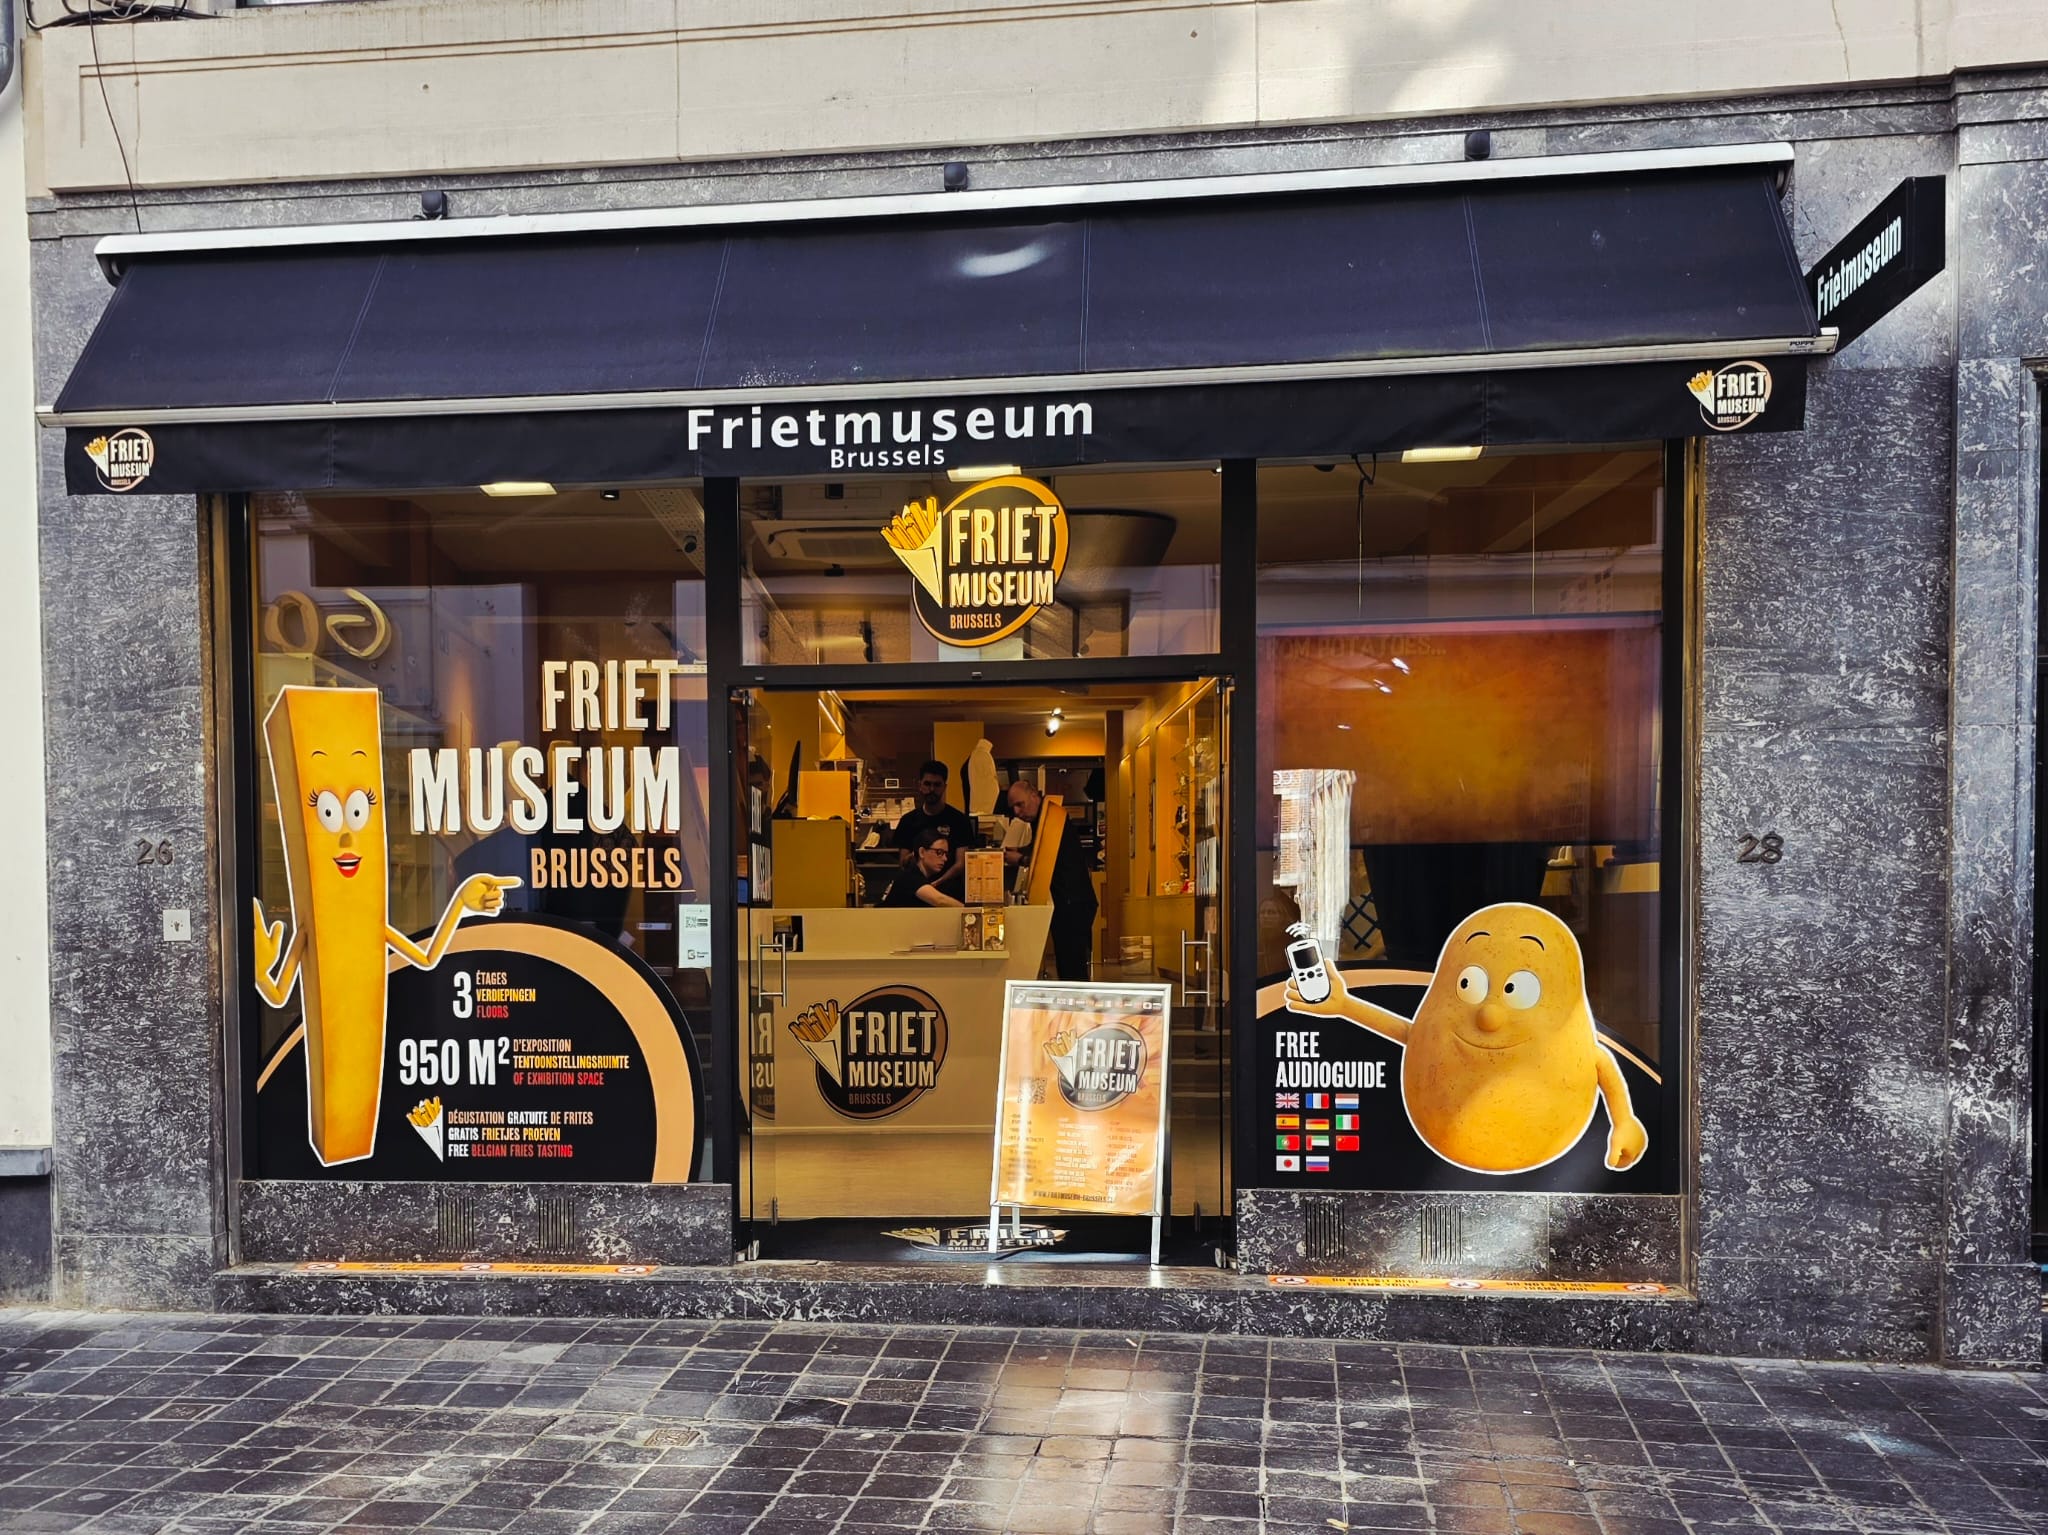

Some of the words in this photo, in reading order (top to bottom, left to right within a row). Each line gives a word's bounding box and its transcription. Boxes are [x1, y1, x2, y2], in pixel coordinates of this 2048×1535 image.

[1817, 215, 1902, 322] Frietmuseum
[1716, 371, 1768, 398] FRIET
[1716, 397, 1766, 415] MUSEUM
[687, 401, 1094, 451] Frietmuseum
[109, 438, 150, 462] FRIET
[830, 444, 945, 469] Brussels
[110, 461, 150, 478] MUSEUM
[949, 506, 1058, 567] FRIET
[949, 570, 1055, 608] MUSEUM
[949, 613, 1002, 630] BRUSSELS
[542, 659, 679, 732] FRIET
[408, 746, 681, 835] MUSEUM
[136, 838, 174, 866] 26
[1736, 831, 1784, 865] 28
[531, 847, 683, 889] BRUSSELS
[475, 970, 508, 985] ÉTAGES
[452, 970, 473, 1019] 3
[475, 988, 536, 1002] VERDIEPINGEN
[475, 1004, 509, 1019] FLOORS
[513, 1038, 572, 1052] D'EXPOSITION
[848, 1011, 937, 1056] FRIET
[1275, 1031, 1320, 1058] FREE
[399, 1038, 460, 1086] 950
[513, 1055, 630, 1070] TENTOONSTELLINGSRUIMTE
[1080, 1038, 1141, 1071] FRIET
[513, 1071, 524, 1086] OF
[527, 1071, 575, 1086] EXHIBITION
[577, 1071, 605, 1086] SPACE
[848, 1060, 935, 1088] MUSEUM
[1078, 1071, 1137, 1093] MUSEUM
[1275, 1061, 1387, 1088] AUDIOGUIDE
[848, 1093, 892, 1105] BRUSSELS
[447, 1108, 505, 1125] DÉGUSTATION
[507, 1111, 549, 1125] GRATUITE
[550, 1111, 561, 1125] DE
[563, 1111, 594, 1125] FRITES
[448, 1127, 479, 1141] GRATIS
[481, 1127, 521, 1141] FRIETJES
[522, 1127, 561, 1142] PROEVEN
[448, 1143, 469, 1157] FREE
[471, 1144, 507, 1158] BELGIAN
[509, 1144, 534, 1158] FRIES
[537, 1144, 574, 1158] TASTING
[948, 1238, 1055, 1247] MUEUM
